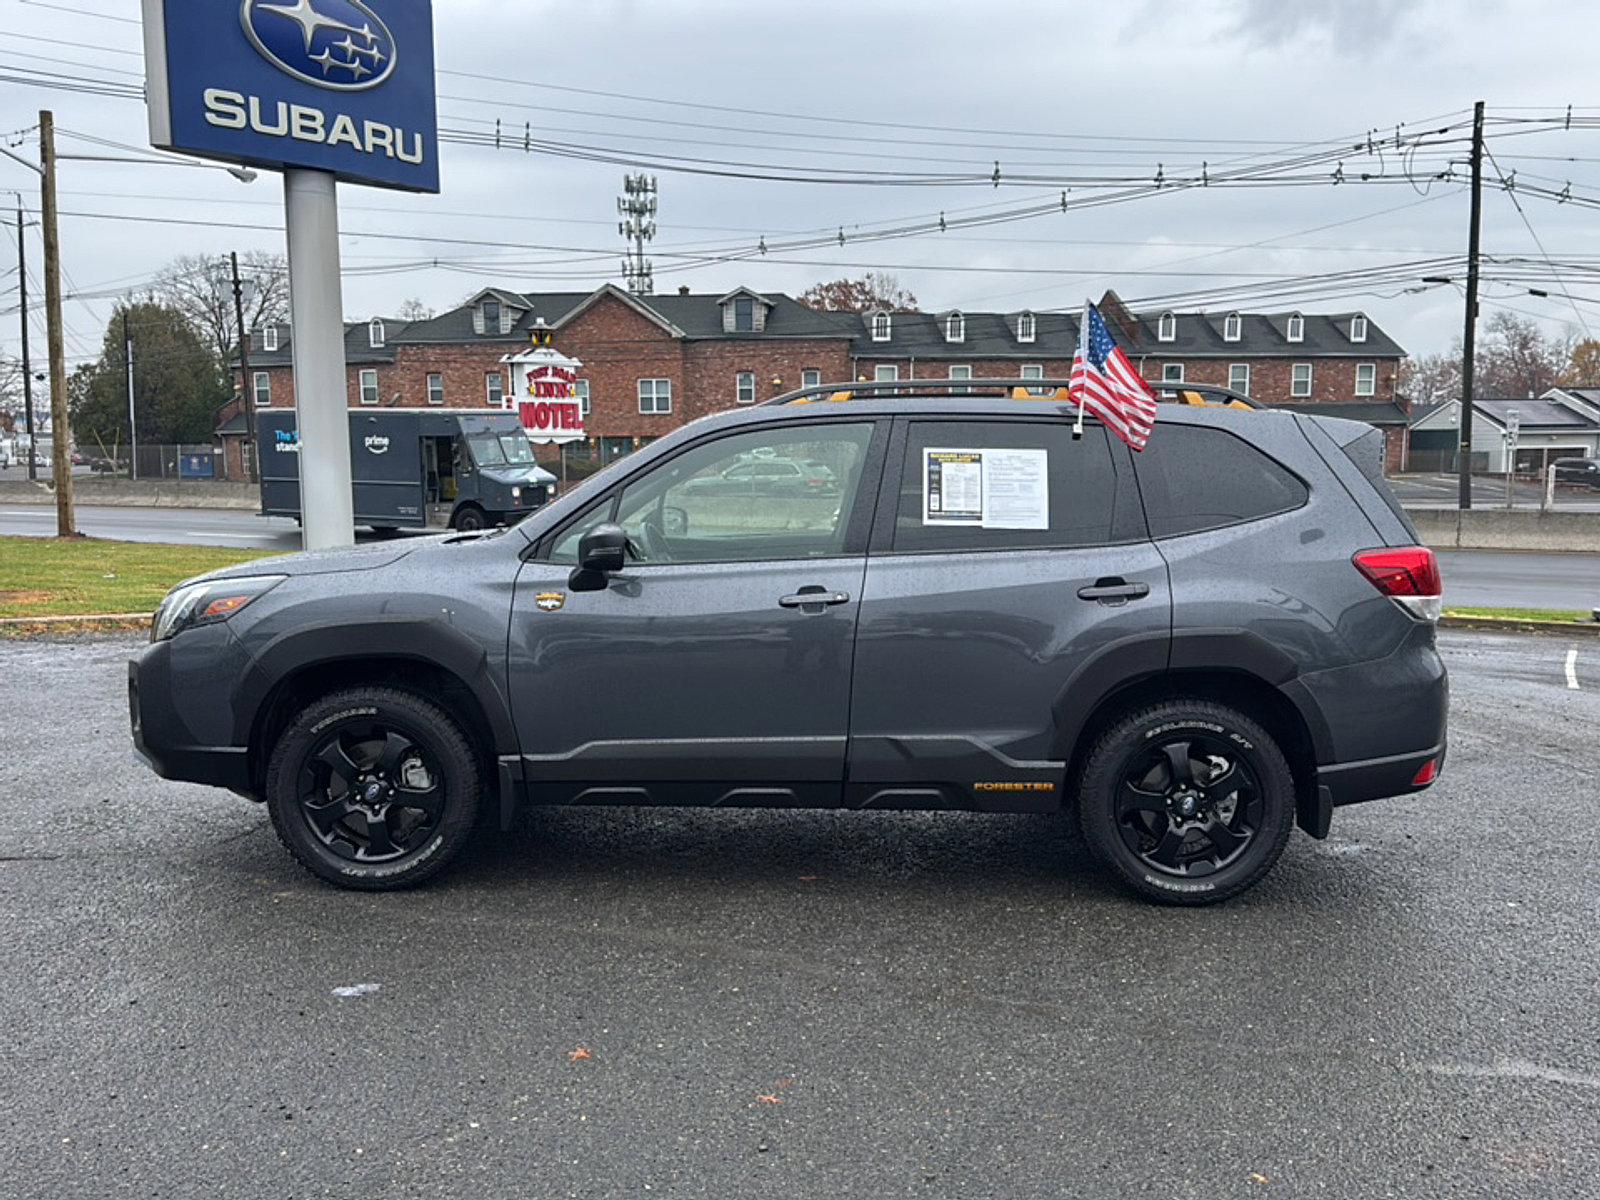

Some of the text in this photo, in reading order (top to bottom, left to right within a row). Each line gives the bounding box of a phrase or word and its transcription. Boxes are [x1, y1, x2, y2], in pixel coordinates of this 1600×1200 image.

[203, 88, 423, 165] SUBARU
[534, 382, 568, 397] INN
[519, 402, 584, 429] MOTEL
[275, 430, 291, 441] The
[365, 435, 389, 447] prime
[973, 782, 1055, 791] FORESTER
